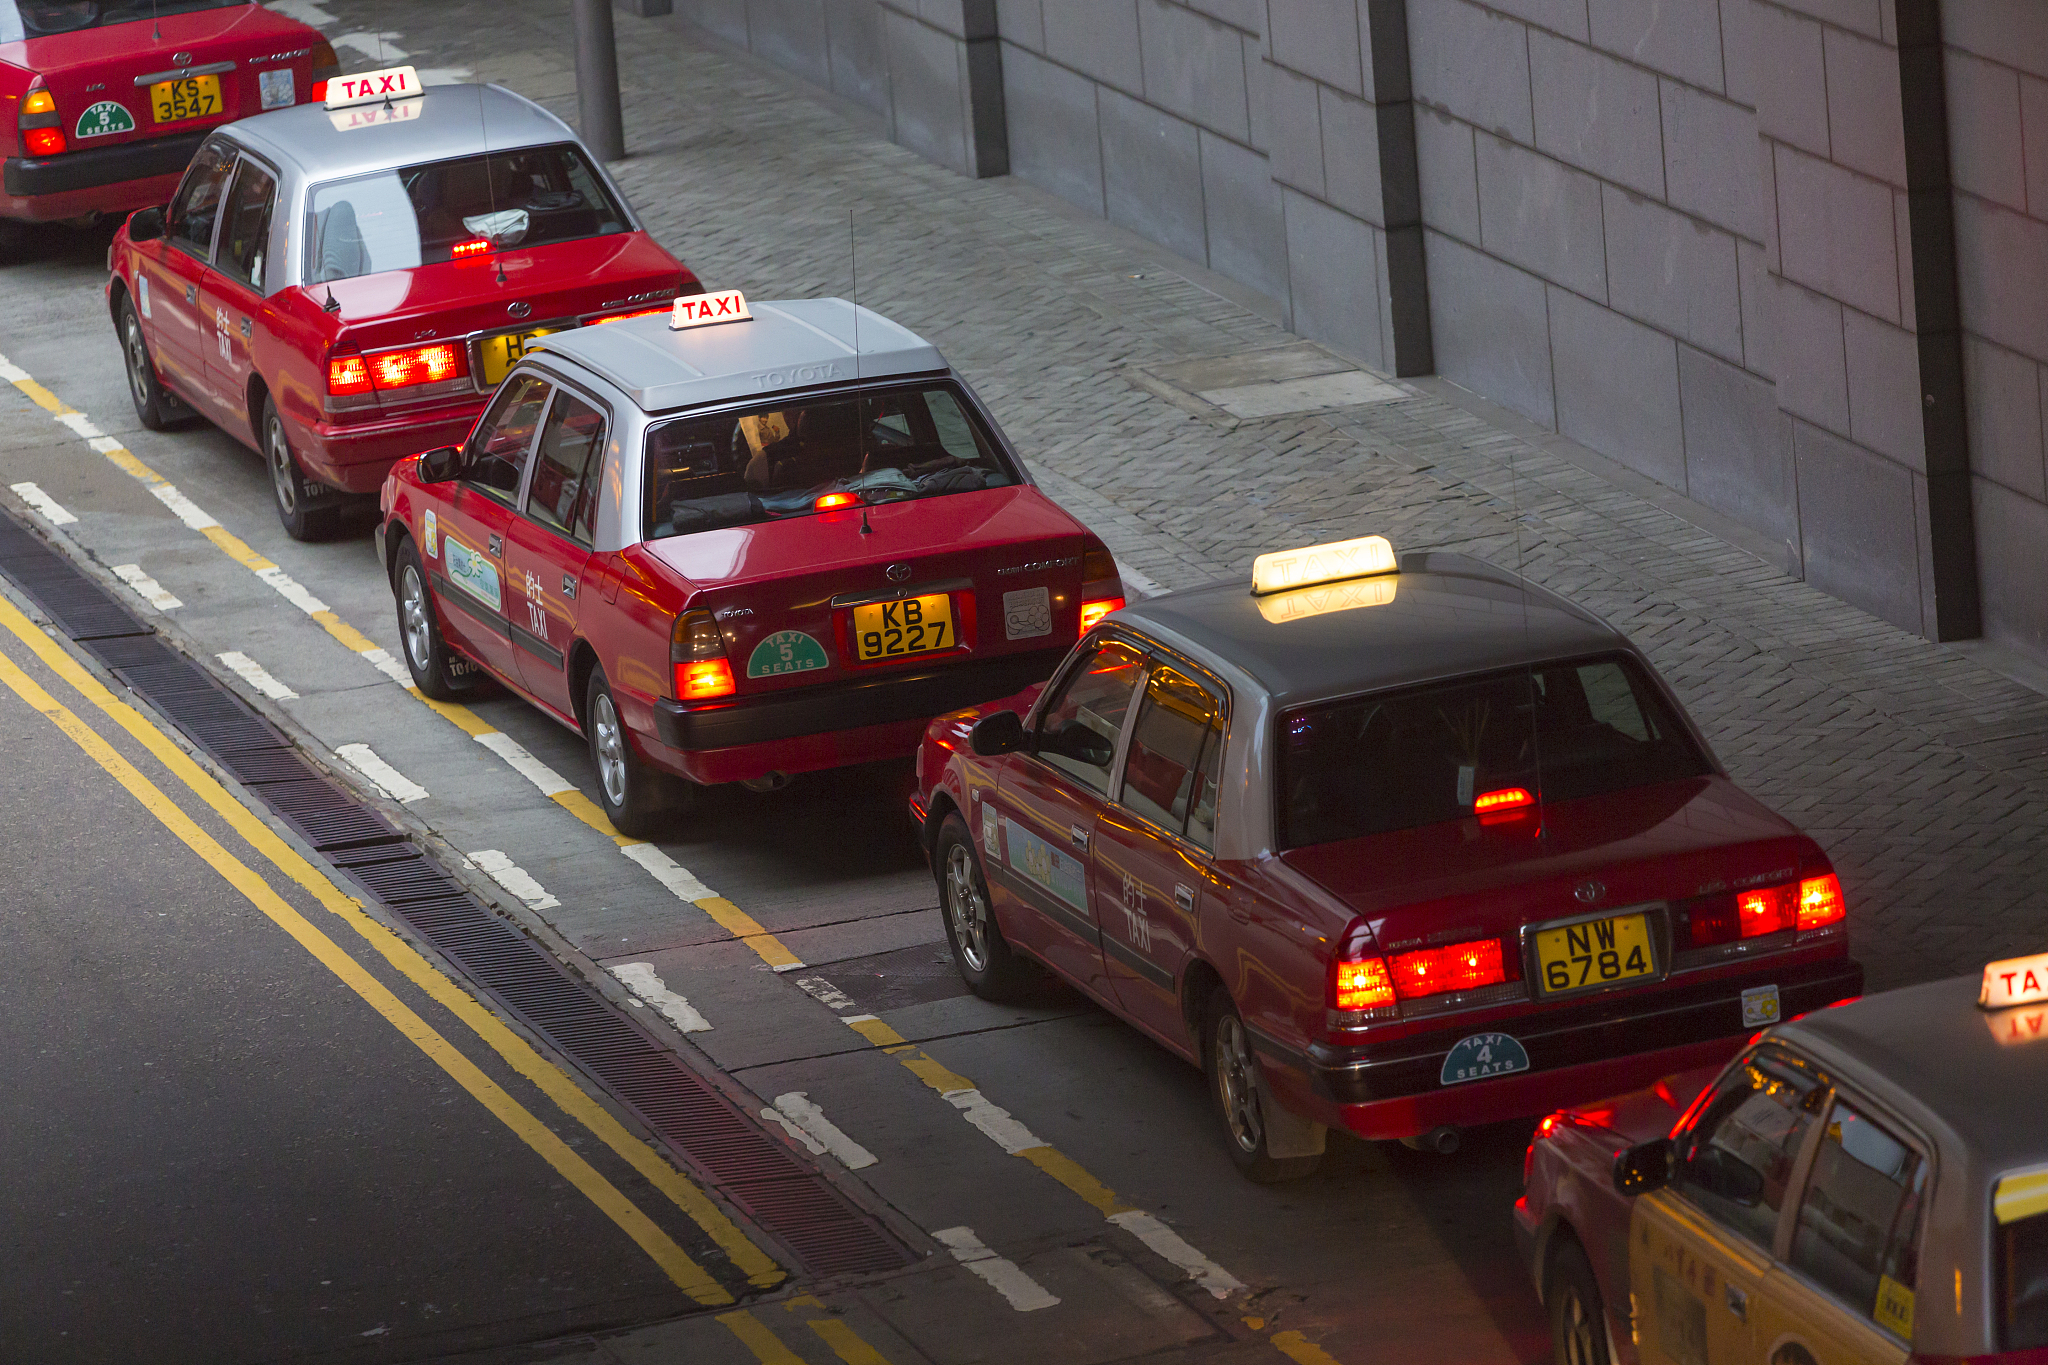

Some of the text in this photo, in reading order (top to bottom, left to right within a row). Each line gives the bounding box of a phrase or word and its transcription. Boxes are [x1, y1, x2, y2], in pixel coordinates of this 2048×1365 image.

[172, 79, 199, 100] KS
[342, 74, 406, 98] TAXI
[90, 104, 117, 115] TAXI
[99, 112, 110, 125] 5
[159, 95, 215, 120] 3547
[87, 123, 125, 135] SEATS
[682, 296, 741, 320] TAXI
[752, 363, 845, 389] TOYOTA
[1272, 544, 1380, 583] TAXI
[526, 570, 543, 606] 的士
[527, 601, 549, 640] TAXI
[882, 600, 923, 629] KB
[766, 633, 804, 648] TAXI
[864, 622, 946, 657] 9227
[780, 644, 793, 661] 5
[762, 659, 814, 674] SEATS
[1123, 873, 1147, 916] 的士
[1124, 907, 1151, 953] TAXI
[1566, 920, 1615, 956] NW
[1546, 945, 1647, 989] 6784
[2000, 966, 2048, 996] TA
[1463, 1035, 1502, 1050] TAXI
[1477, 1045, 1492, 1063] 4
[1457, 1060, 1514, 1079] SEATS
